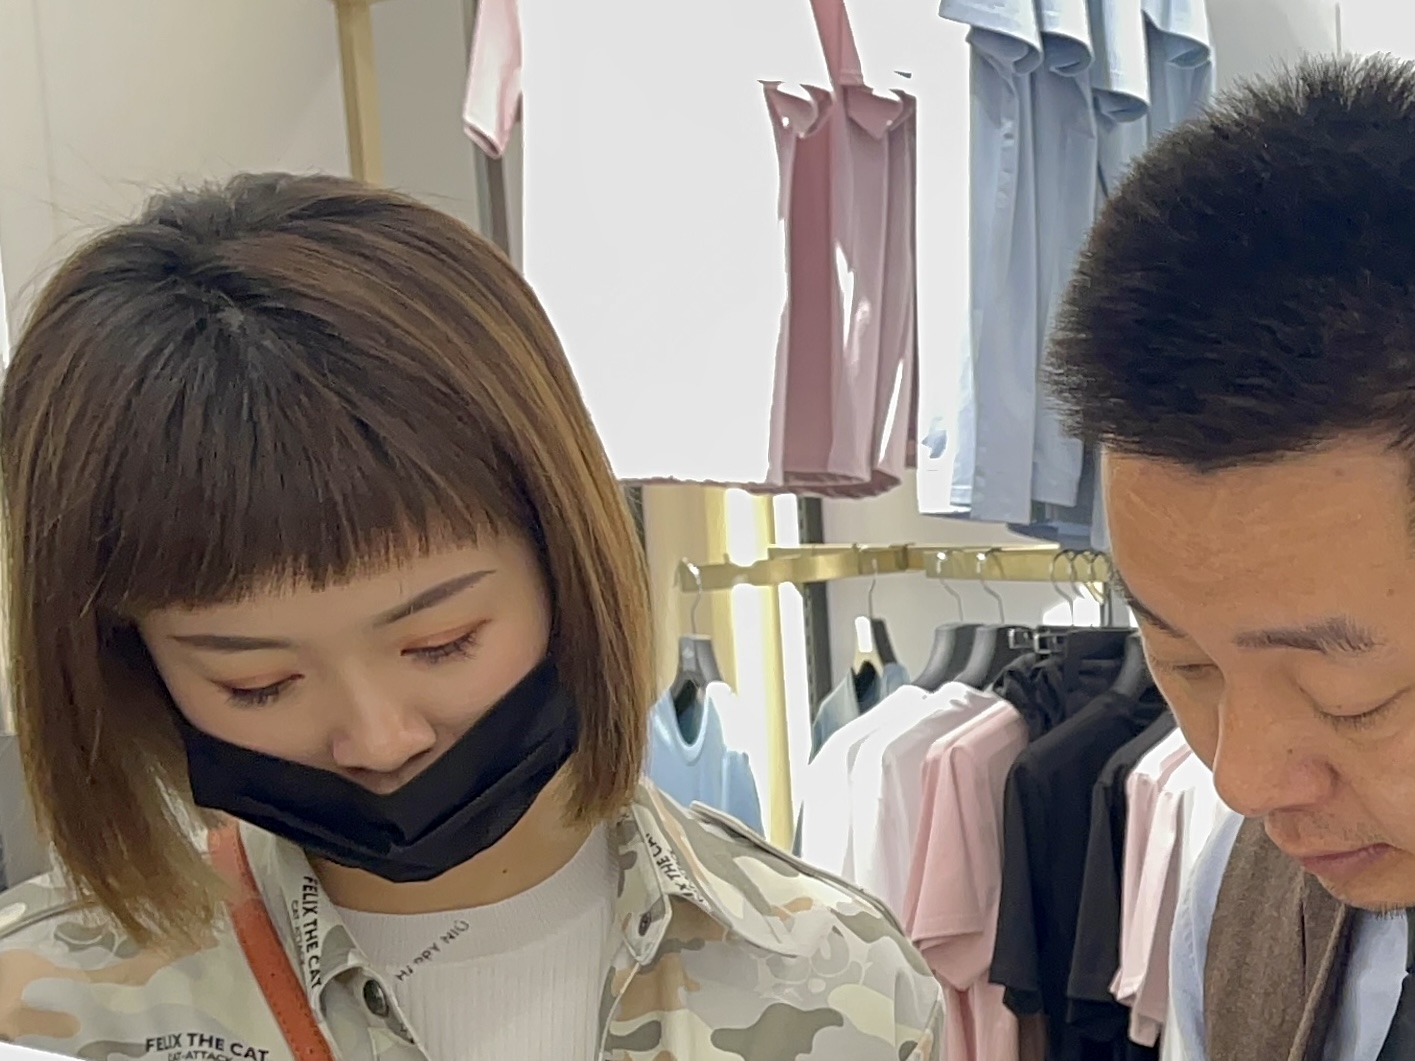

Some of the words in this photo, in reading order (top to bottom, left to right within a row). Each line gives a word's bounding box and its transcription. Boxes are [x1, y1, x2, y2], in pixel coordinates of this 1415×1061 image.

[656, 855, 681, 881] THE
[302, 875, 319, 917] FELIX
[303, 918, 319, 953] THE
[308, 955, 322, 989] CAT
[145, 1033, 183, 1053] FELIX
[186, 1033, 225, 1052] THE
